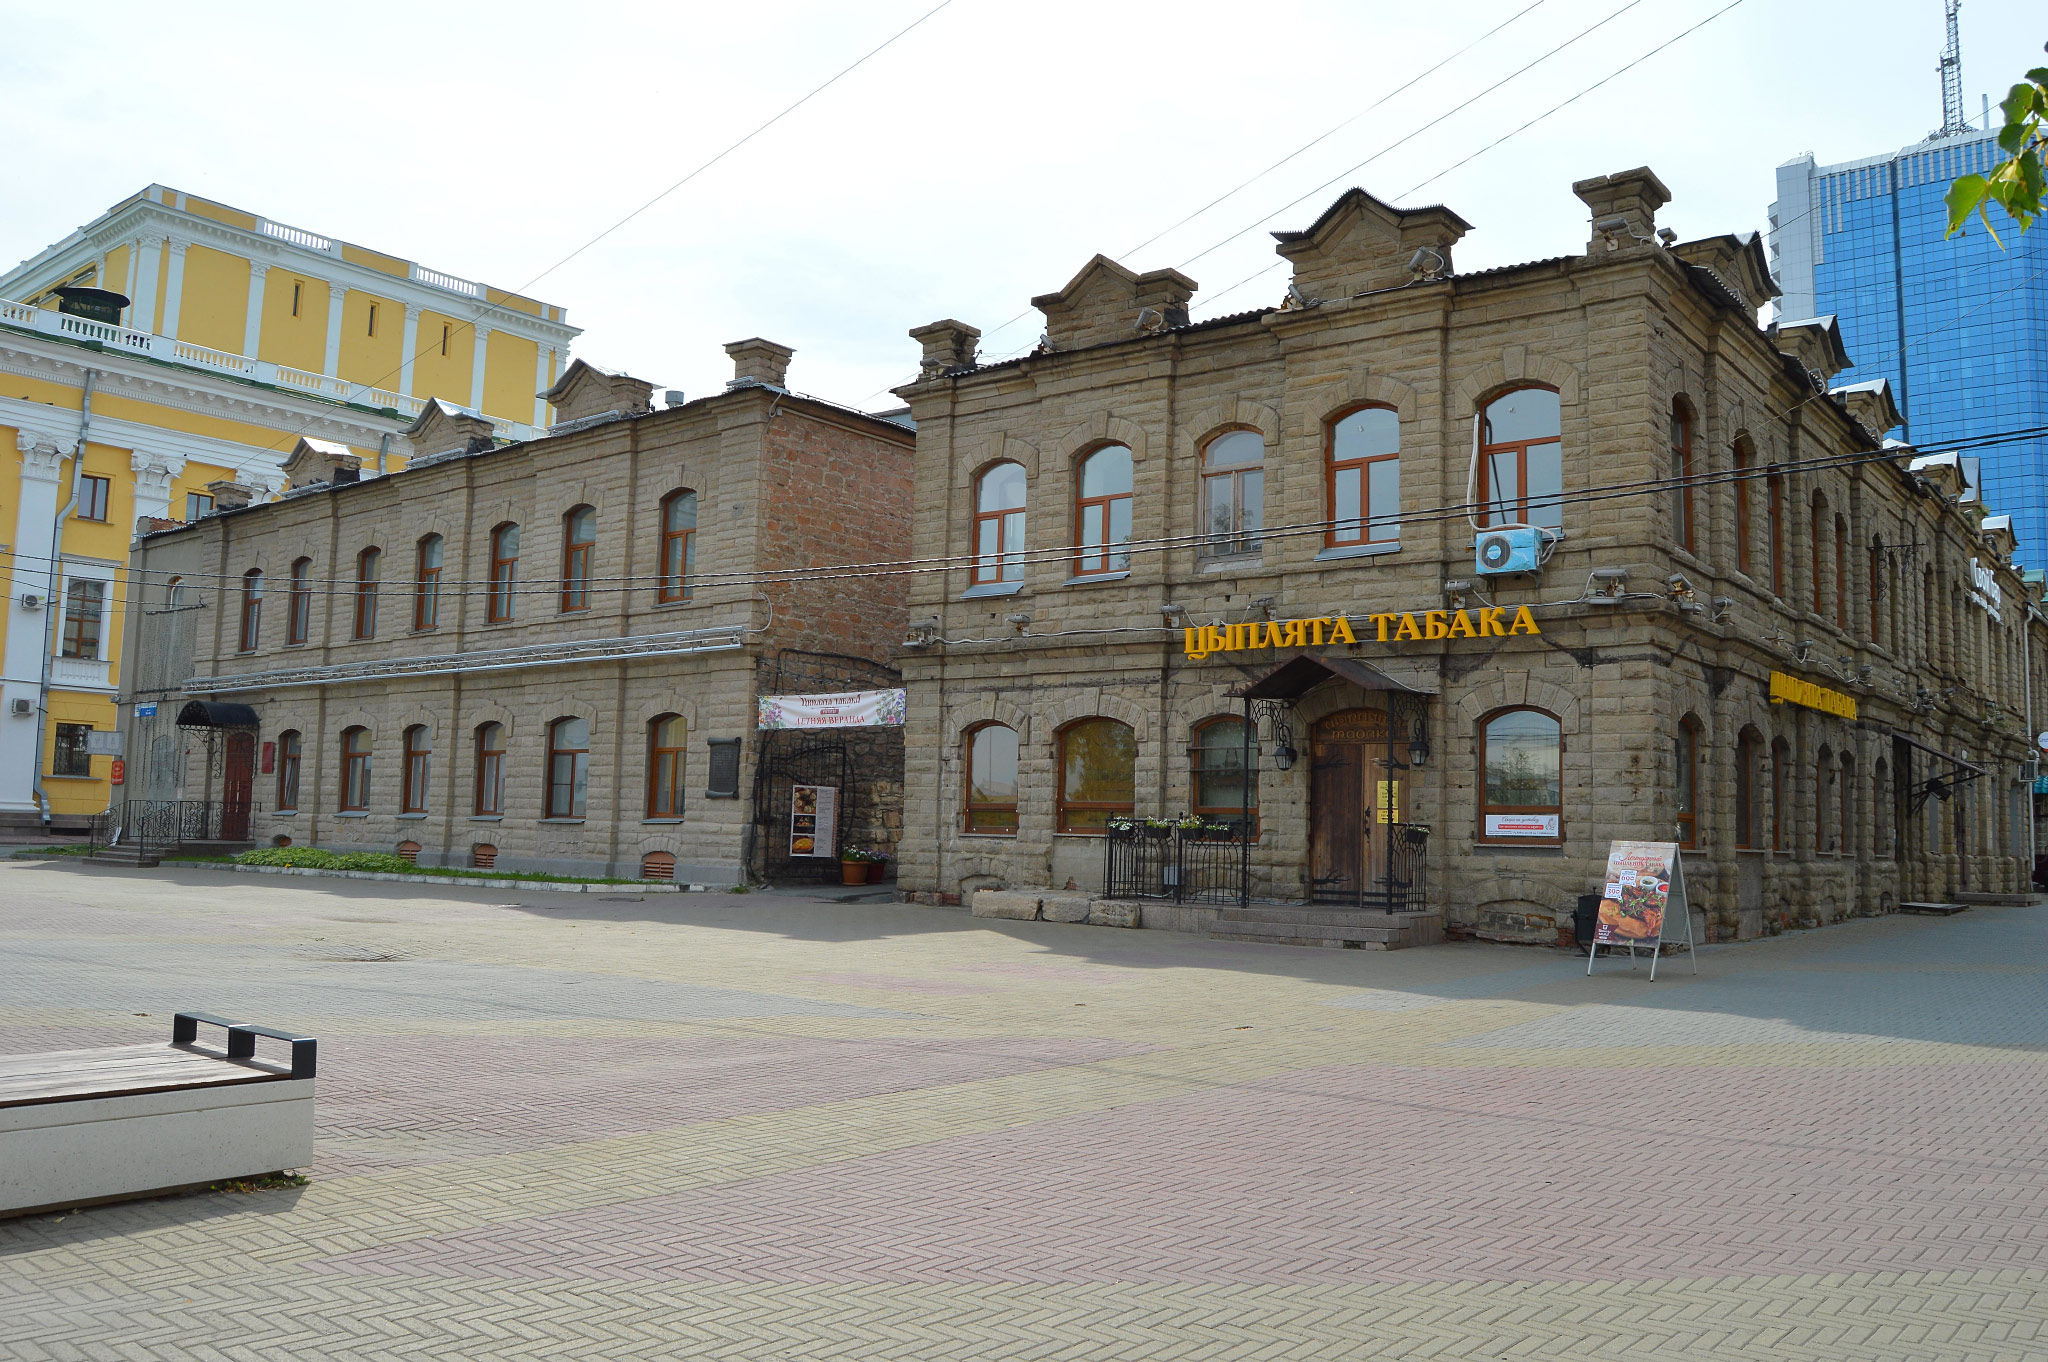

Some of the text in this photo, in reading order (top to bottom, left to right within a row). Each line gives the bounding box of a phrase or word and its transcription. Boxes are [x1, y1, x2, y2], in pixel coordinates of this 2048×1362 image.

[1184, 605, 1541, 660] ЦЫПЛЯТА ТАБАКА
[828, 715, 865, 724] ВЕРАНДА
